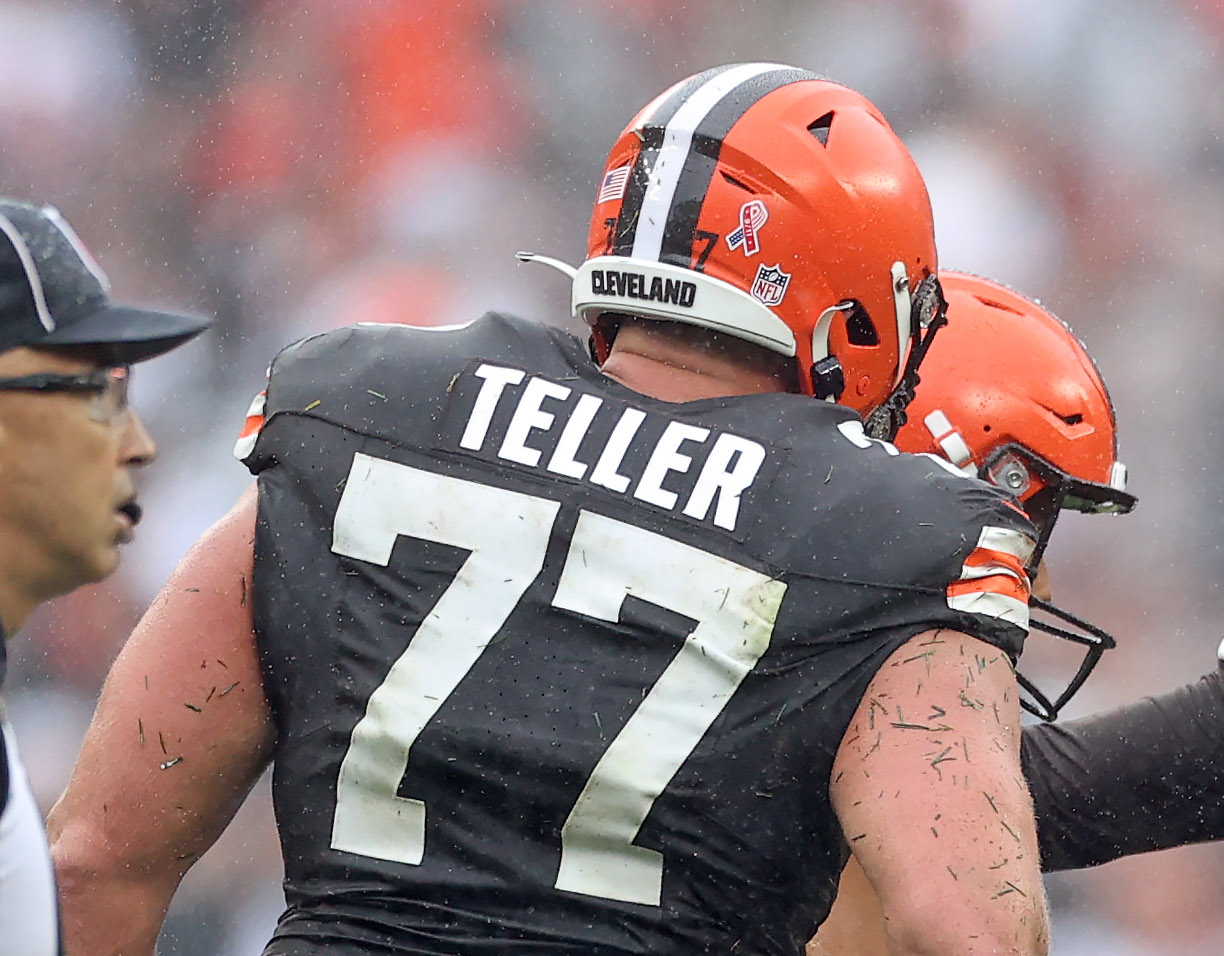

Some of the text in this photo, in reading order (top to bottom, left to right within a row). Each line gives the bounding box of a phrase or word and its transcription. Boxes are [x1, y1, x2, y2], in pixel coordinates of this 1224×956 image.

[693, 230, 719, 273] 7
[591, 270, 697, 308] CLEVELAND
[756, 280, 778, 301] NFL
[459, 363, 766, 531] TELLER
[330, 452, 787, 907] 77
